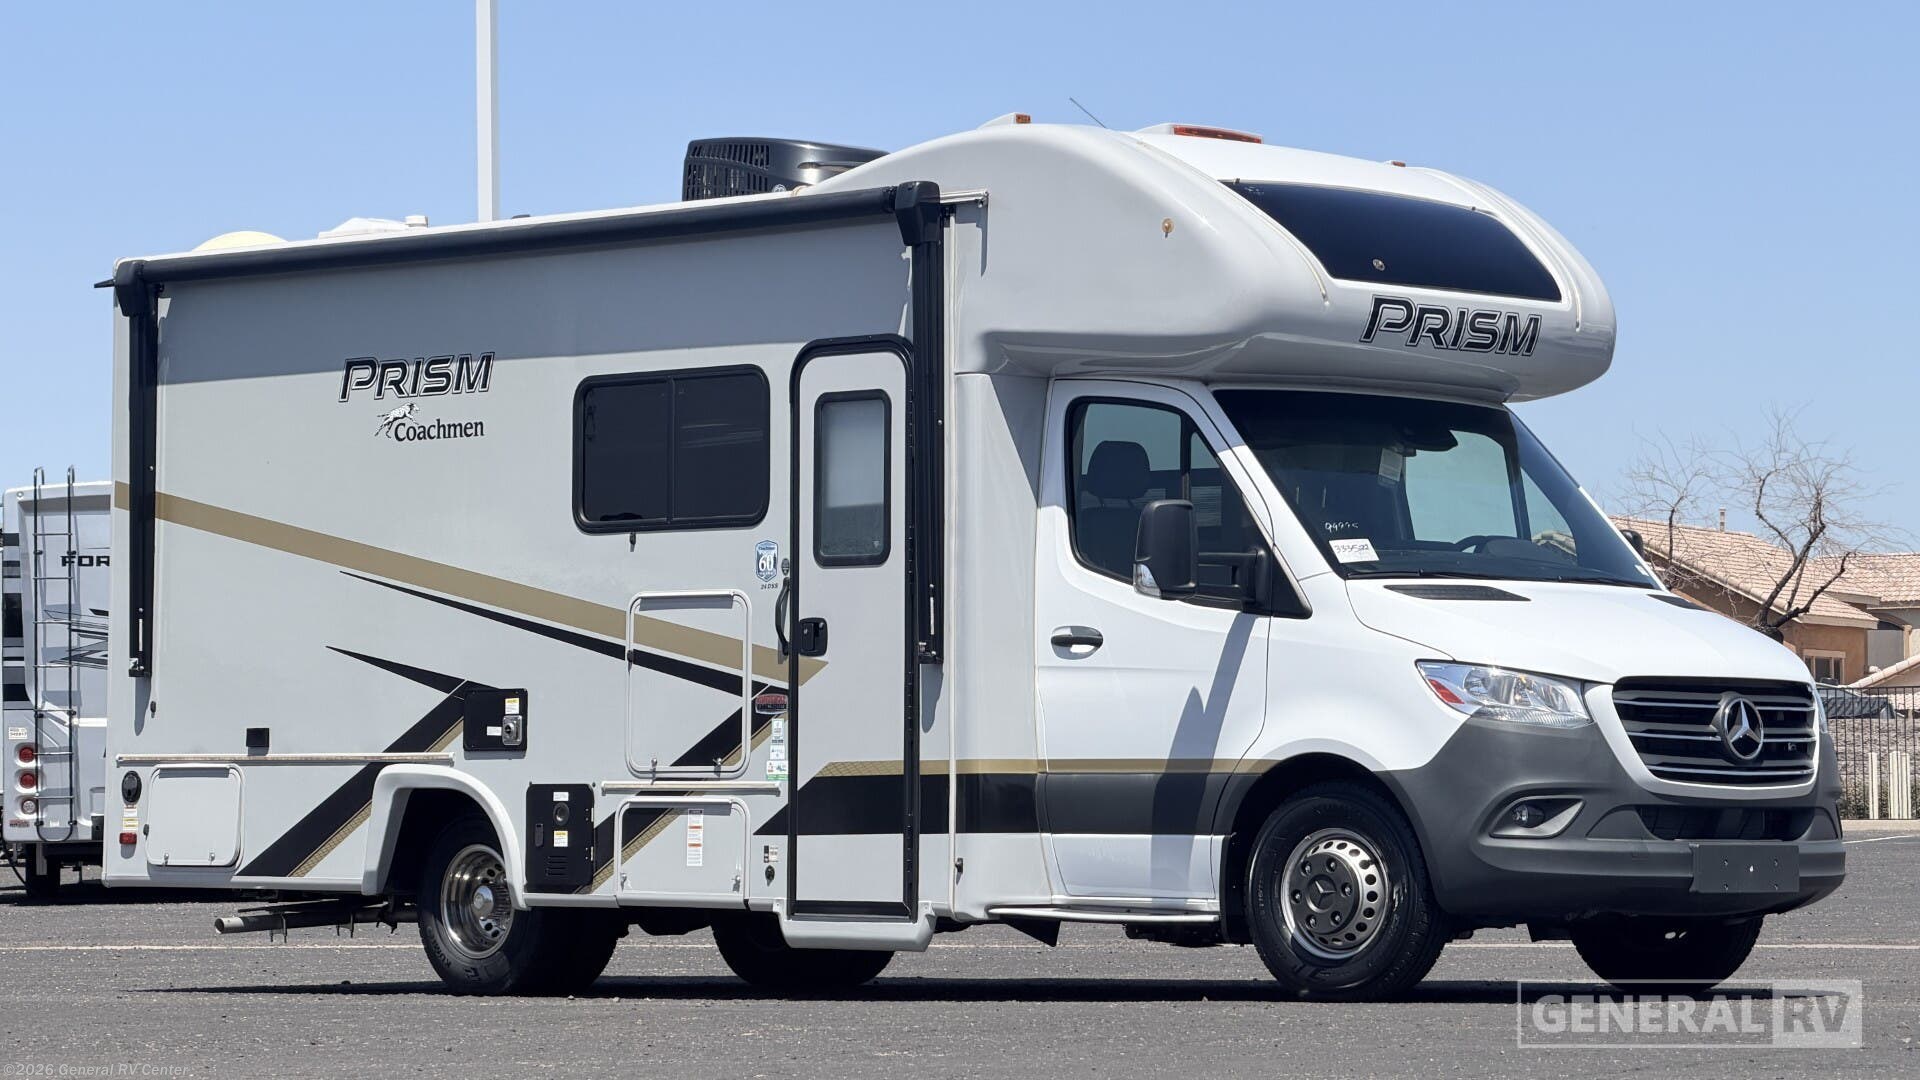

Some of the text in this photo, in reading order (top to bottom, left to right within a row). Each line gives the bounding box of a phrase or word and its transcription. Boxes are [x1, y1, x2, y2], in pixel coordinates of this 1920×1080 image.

[1359, 294, 1542, 356] PRISM
[338, 352, 495, 403] PRISM
[394, 419, 484, 442] Coachmen
